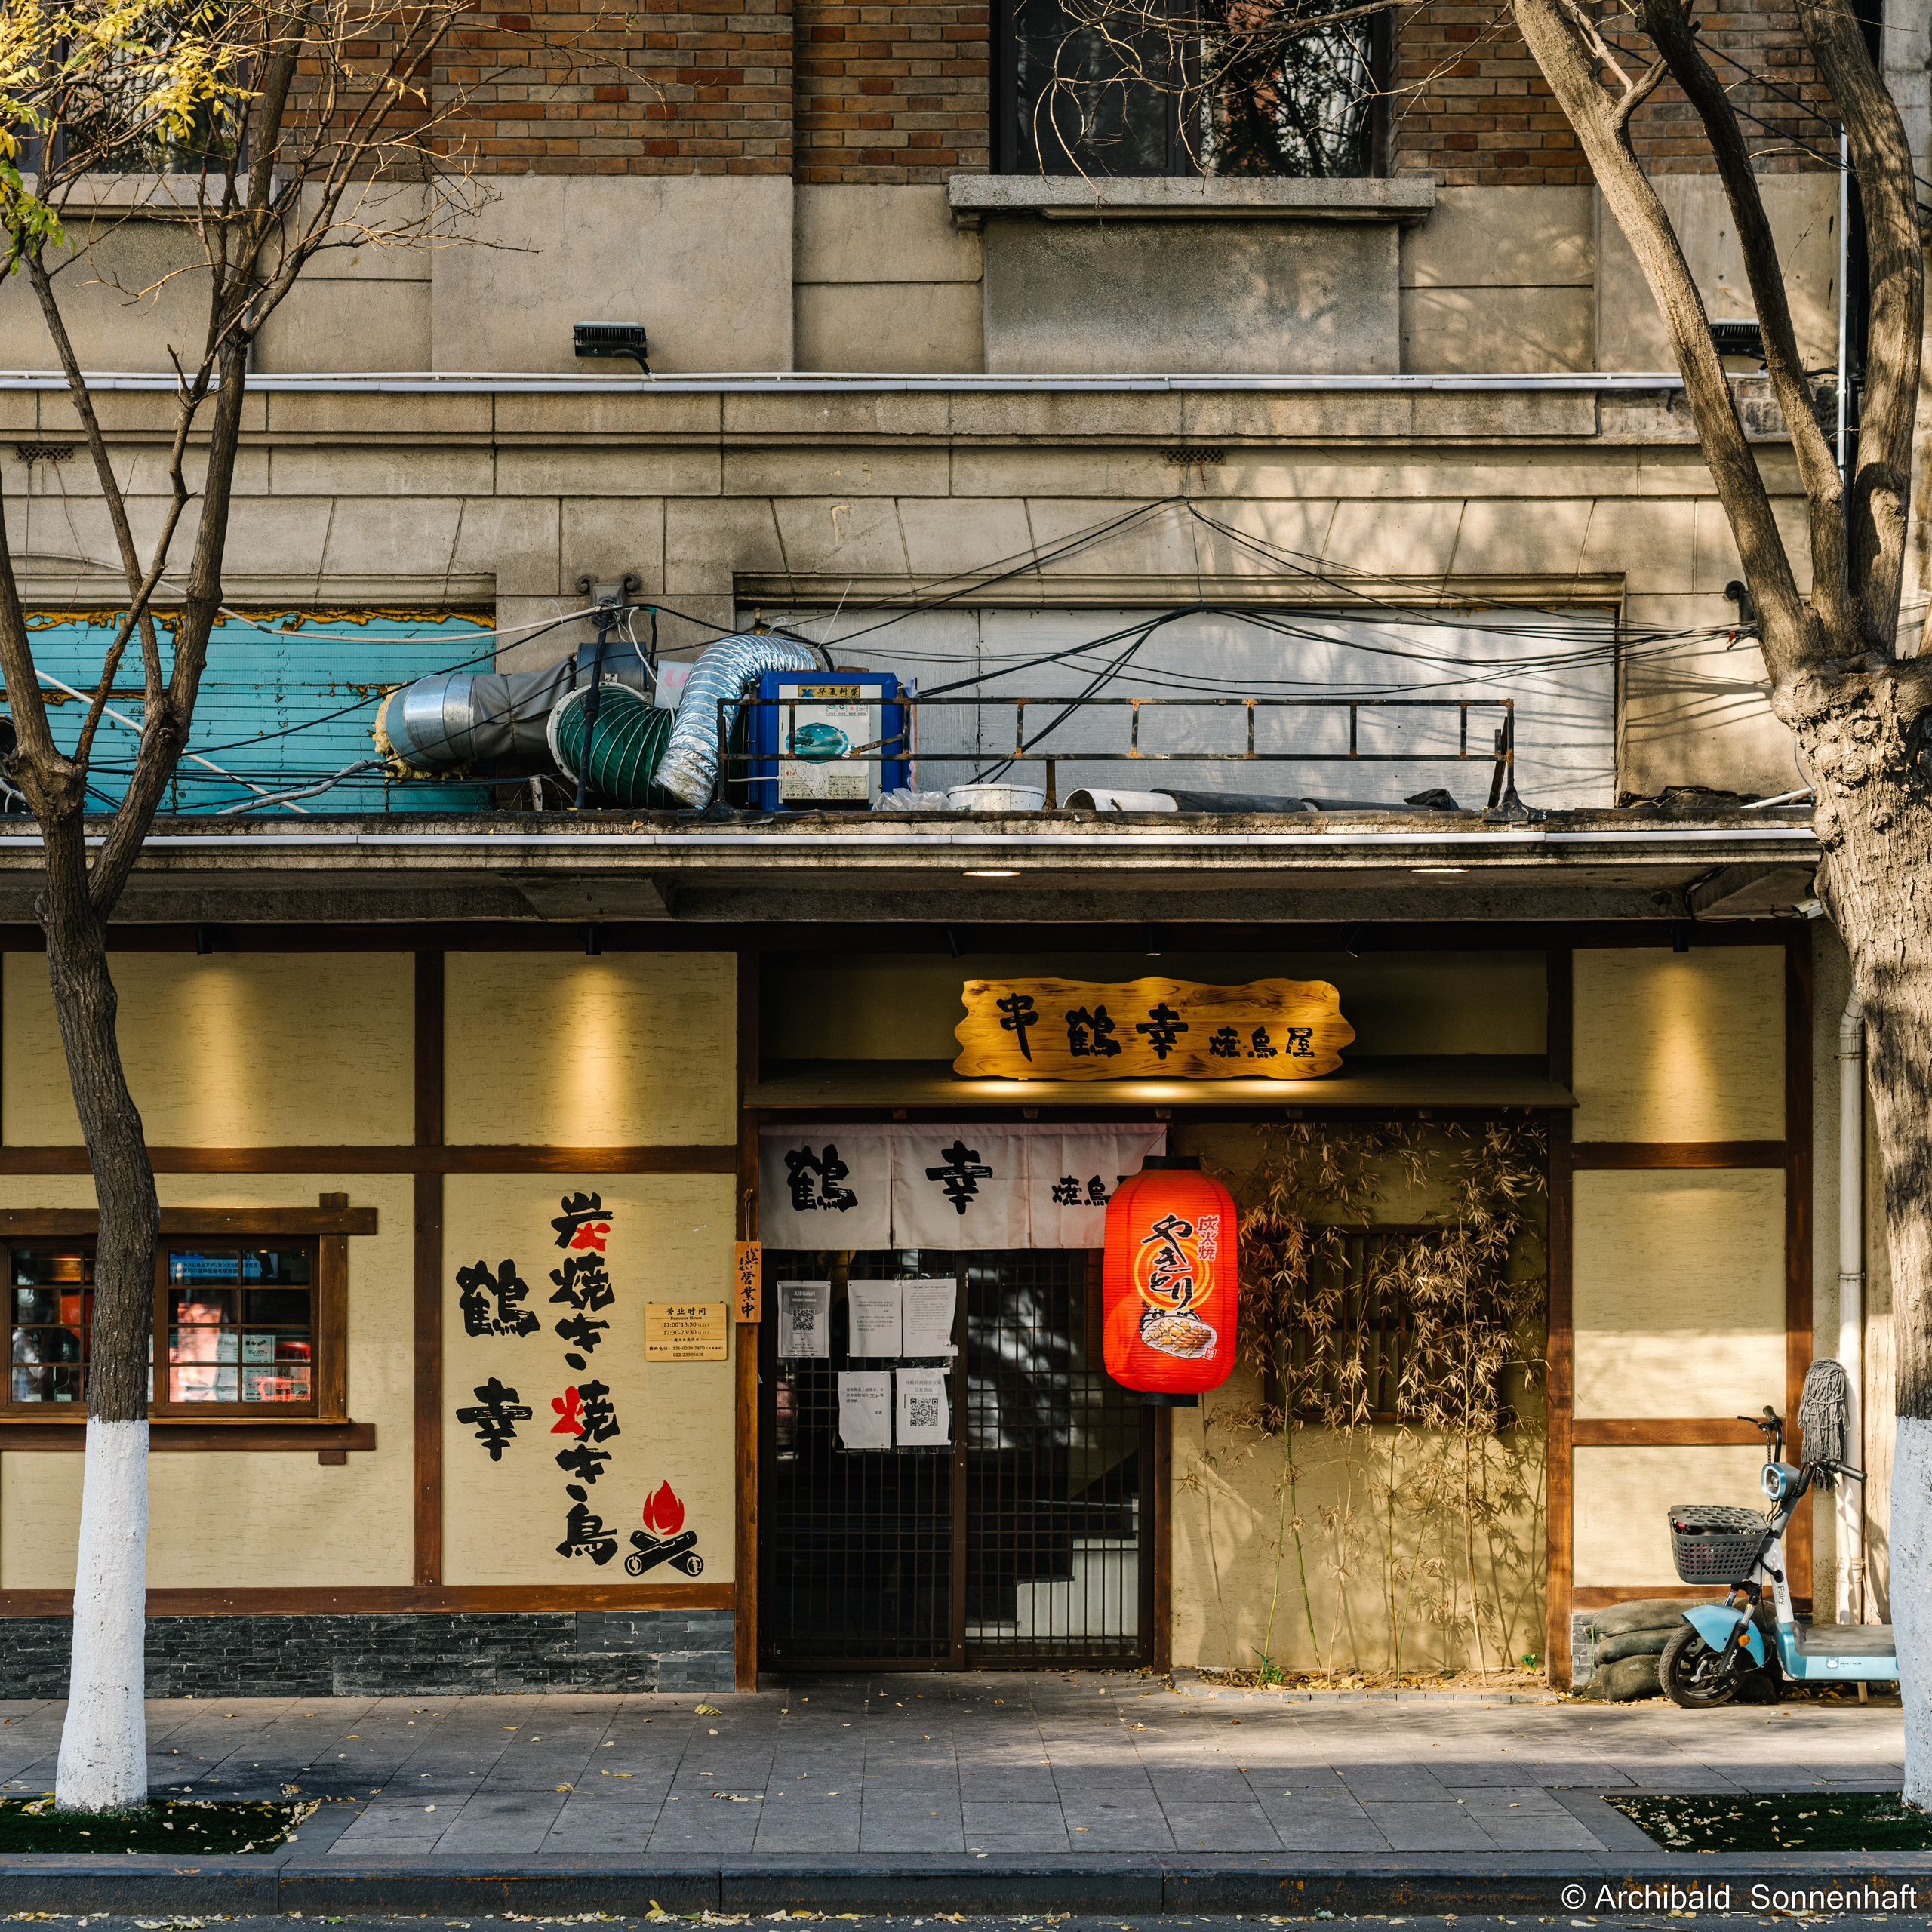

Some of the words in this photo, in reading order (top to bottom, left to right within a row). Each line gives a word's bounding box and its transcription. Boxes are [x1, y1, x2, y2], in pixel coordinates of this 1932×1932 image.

[1052, 1174, 1134, 1206] 焼鳥
[1197, 1208, 1219, 1260] 炭火焼
[1141, 1213, 1194, 1312] やきとり
[666, 1307, 706, 1315] 营业时间
[1777, 1585, 1786, 1606] Fairy
[1727, 1649, 1739, 1670] BATTLE
